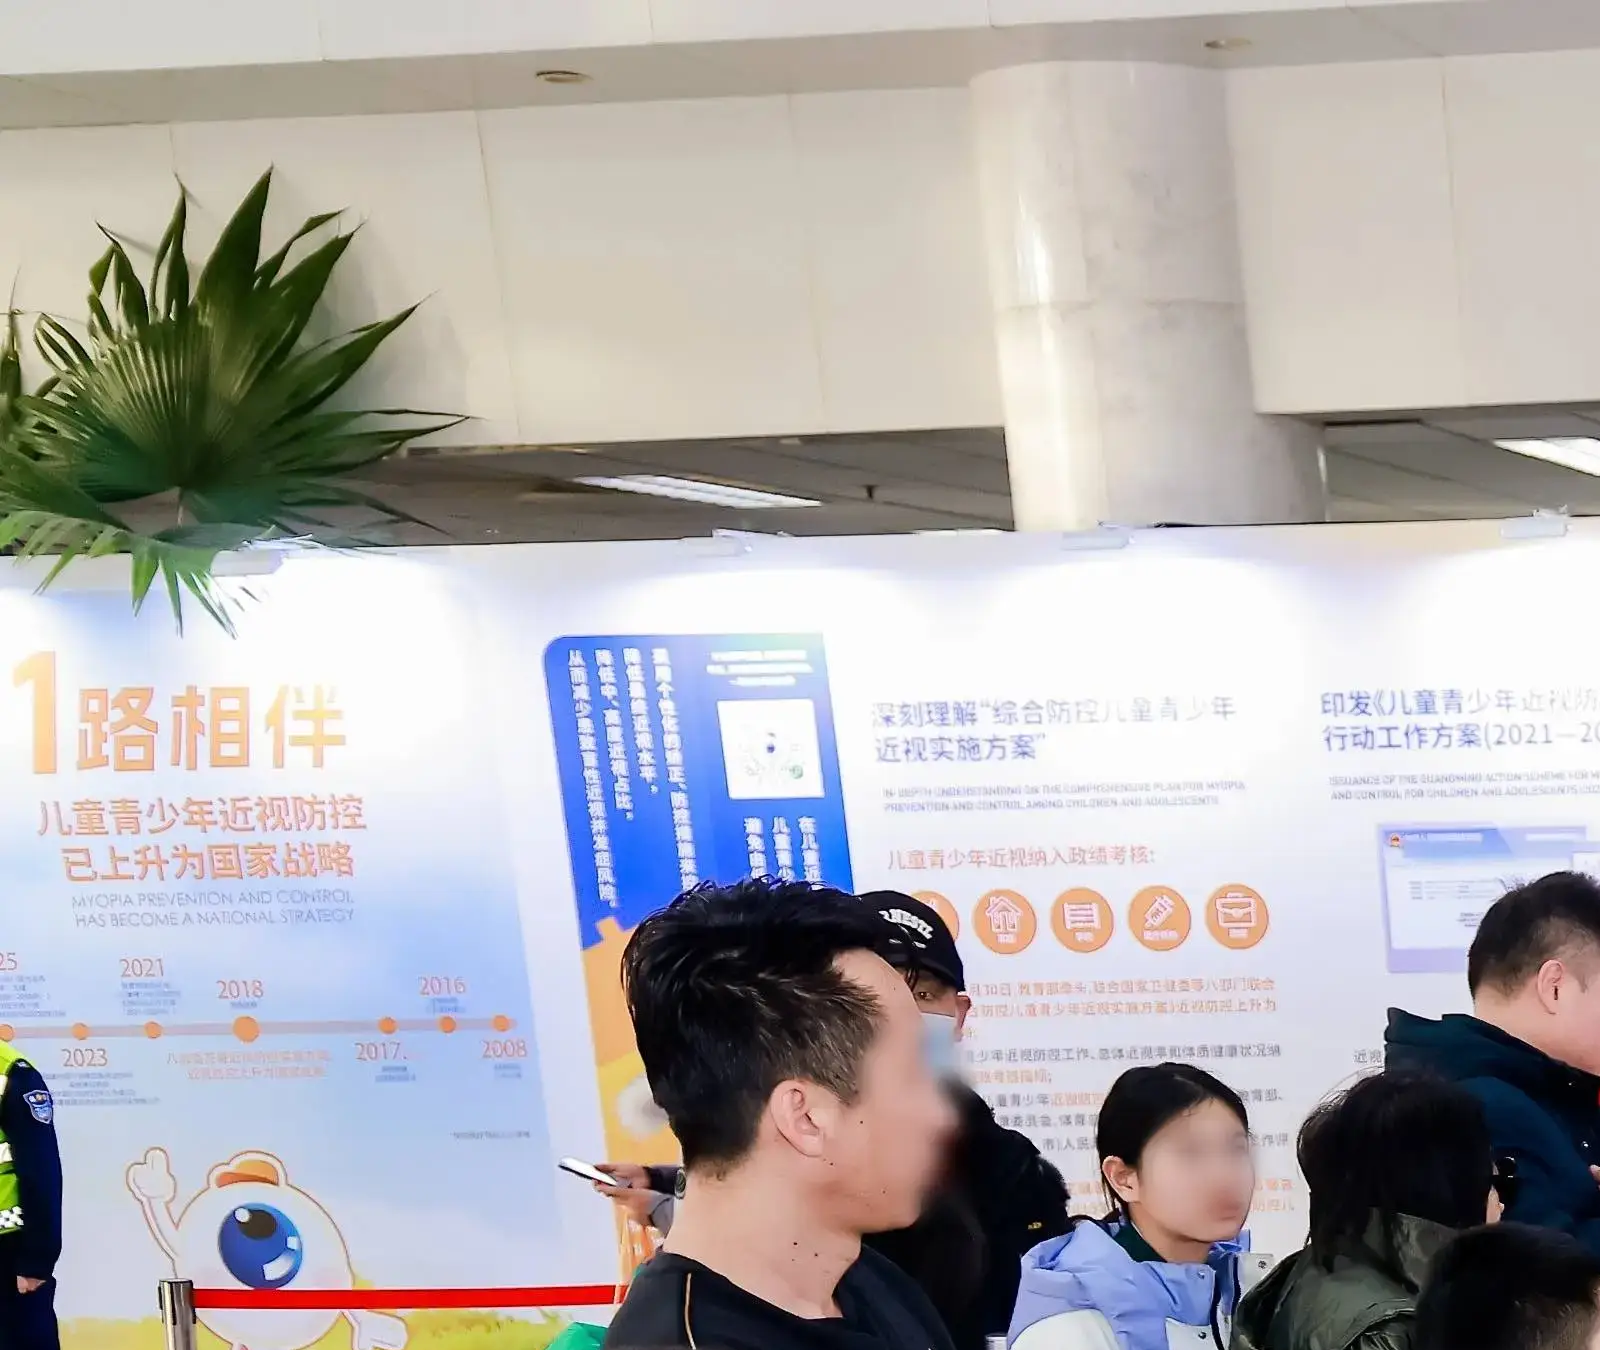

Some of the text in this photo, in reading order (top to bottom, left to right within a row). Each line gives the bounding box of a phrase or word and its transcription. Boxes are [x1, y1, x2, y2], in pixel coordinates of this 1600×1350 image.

[13, 651, 346, 774] 1路相伴
[37, 794, 367, 837] 儿童青少年近视防控
[61, 841, 354, 882] 已上升为国家战略
[72, 891, 134, 909] MYOPIA
[138, 890, 233, 908] PREVENTION
[238, 889, 272, 907] AND
[75, 907, 355, 929] HAS BECOME A NATIONAL STRATEGY
[120, 958, 164, 977] 2021
[216, 980, 264, 1000] 2018
[419, 976, 467, 996] 2016
[61, 1048, 108, 1068] 2023
[482, 1039, 528, 1060] 2008
